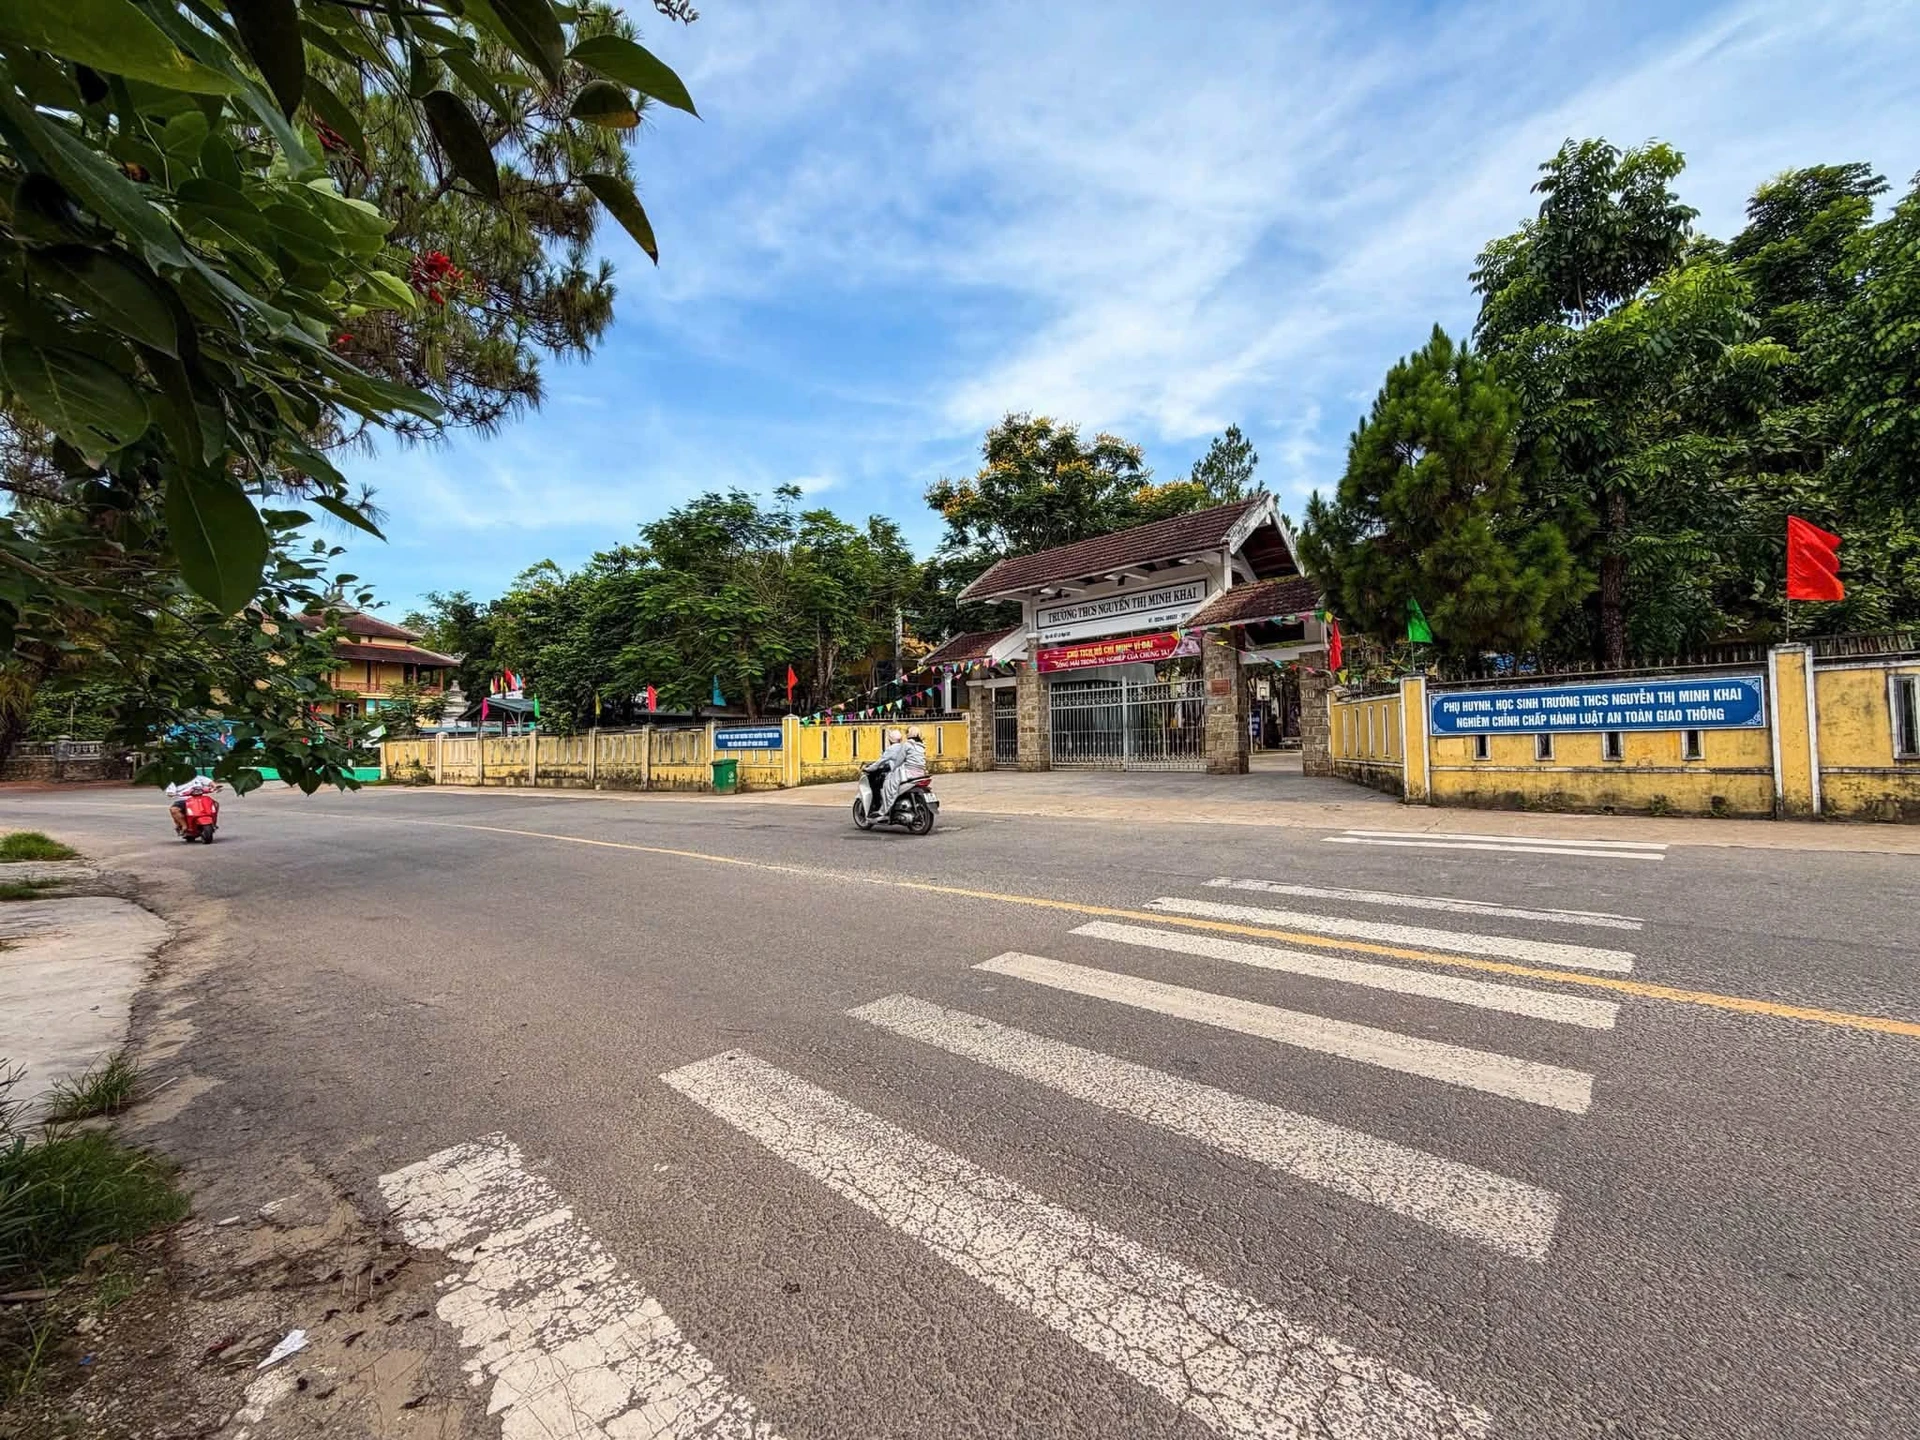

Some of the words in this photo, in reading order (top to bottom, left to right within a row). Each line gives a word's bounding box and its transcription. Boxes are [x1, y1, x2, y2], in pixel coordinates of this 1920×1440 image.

[1078, 605, 1097, 618] THCS
[1148, 591, 1172, 606] MINH
[1173, 587, 1197, 602] KHAI
[1443, 701, 1460, 715] PHỤ
[1496, 698, 1514, 712] HỌC
[1516, 697, 1538, 709] SINH
[1541, 694, 1580, 708] TRƯỜNG
[1583, 694, 1608, 707] THCS
[1612, 688, 1654, 705] NGUYỄN
[1658, 691, 1675, 705] THỊ
[1679, 689, 1710, 702] MINH
[1714, 688, 1742, 701] KHAI
[1456, 714, 1489, 728] NGHIÊM
[1492, 712, 1520, 727] CHỈNH
[1522, 711, 1546, 726] CHẤP
[1550, 711, 1577, 725] HÀNH
[1580, 710, 1603, 727] LUẬT
[1607, 711, 1621, 723] AN
[1624, 708, 1652, 723] TOÀN
[1656, 709, 1682, 722] GIAO
[1685, 706, 1725, 721] THÔNG
